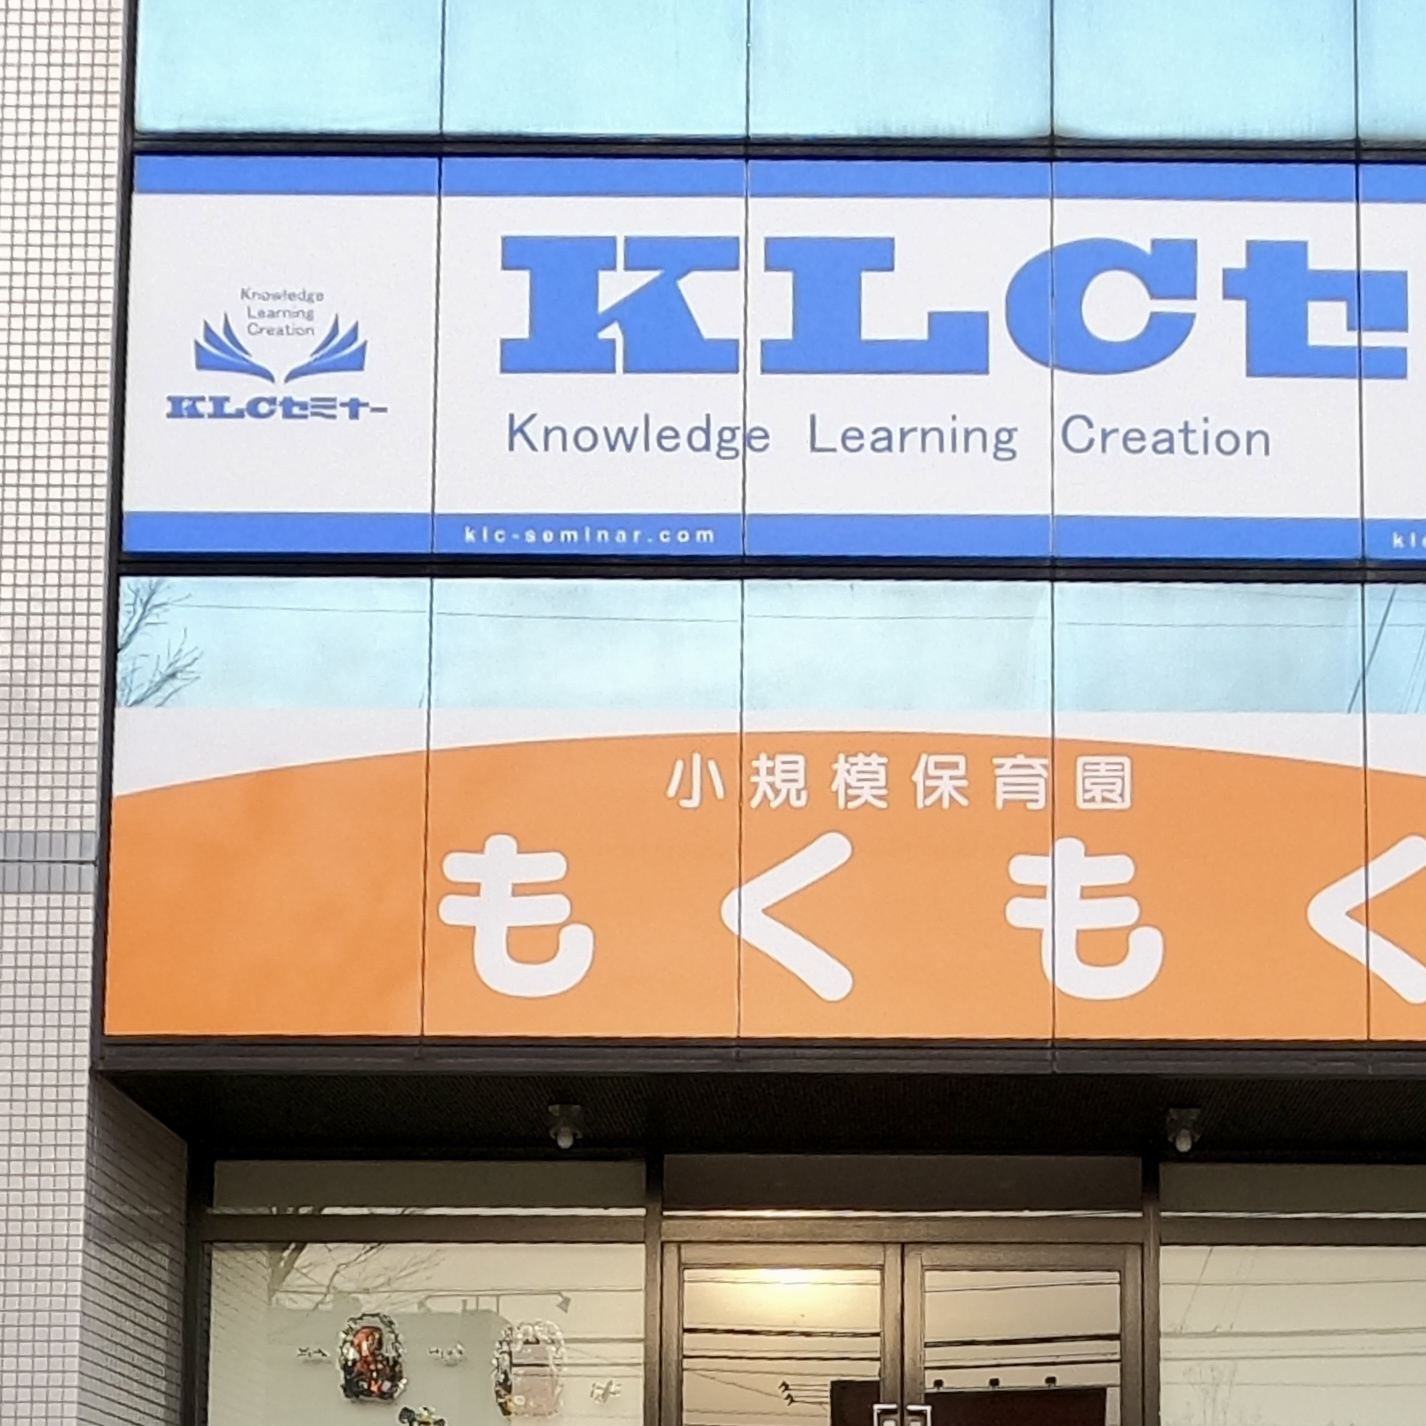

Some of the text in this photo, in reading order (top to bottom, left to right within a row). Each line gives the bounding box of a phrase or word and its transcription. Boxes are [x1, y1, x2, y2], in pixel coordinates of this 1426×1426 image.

[240, 287, 325, 304] Knowledge
[247, 305, 315, 321] Learning
[246, 322, 315, 337] Creation
[165, 394, 388, 421] KLCセミナー
[508, 412, 1272, 462] Knowledge Learning Creation
[464, 525, 715, 545] klc-seminar.com
[665, 752, 1134, 811] 小規模保育園
